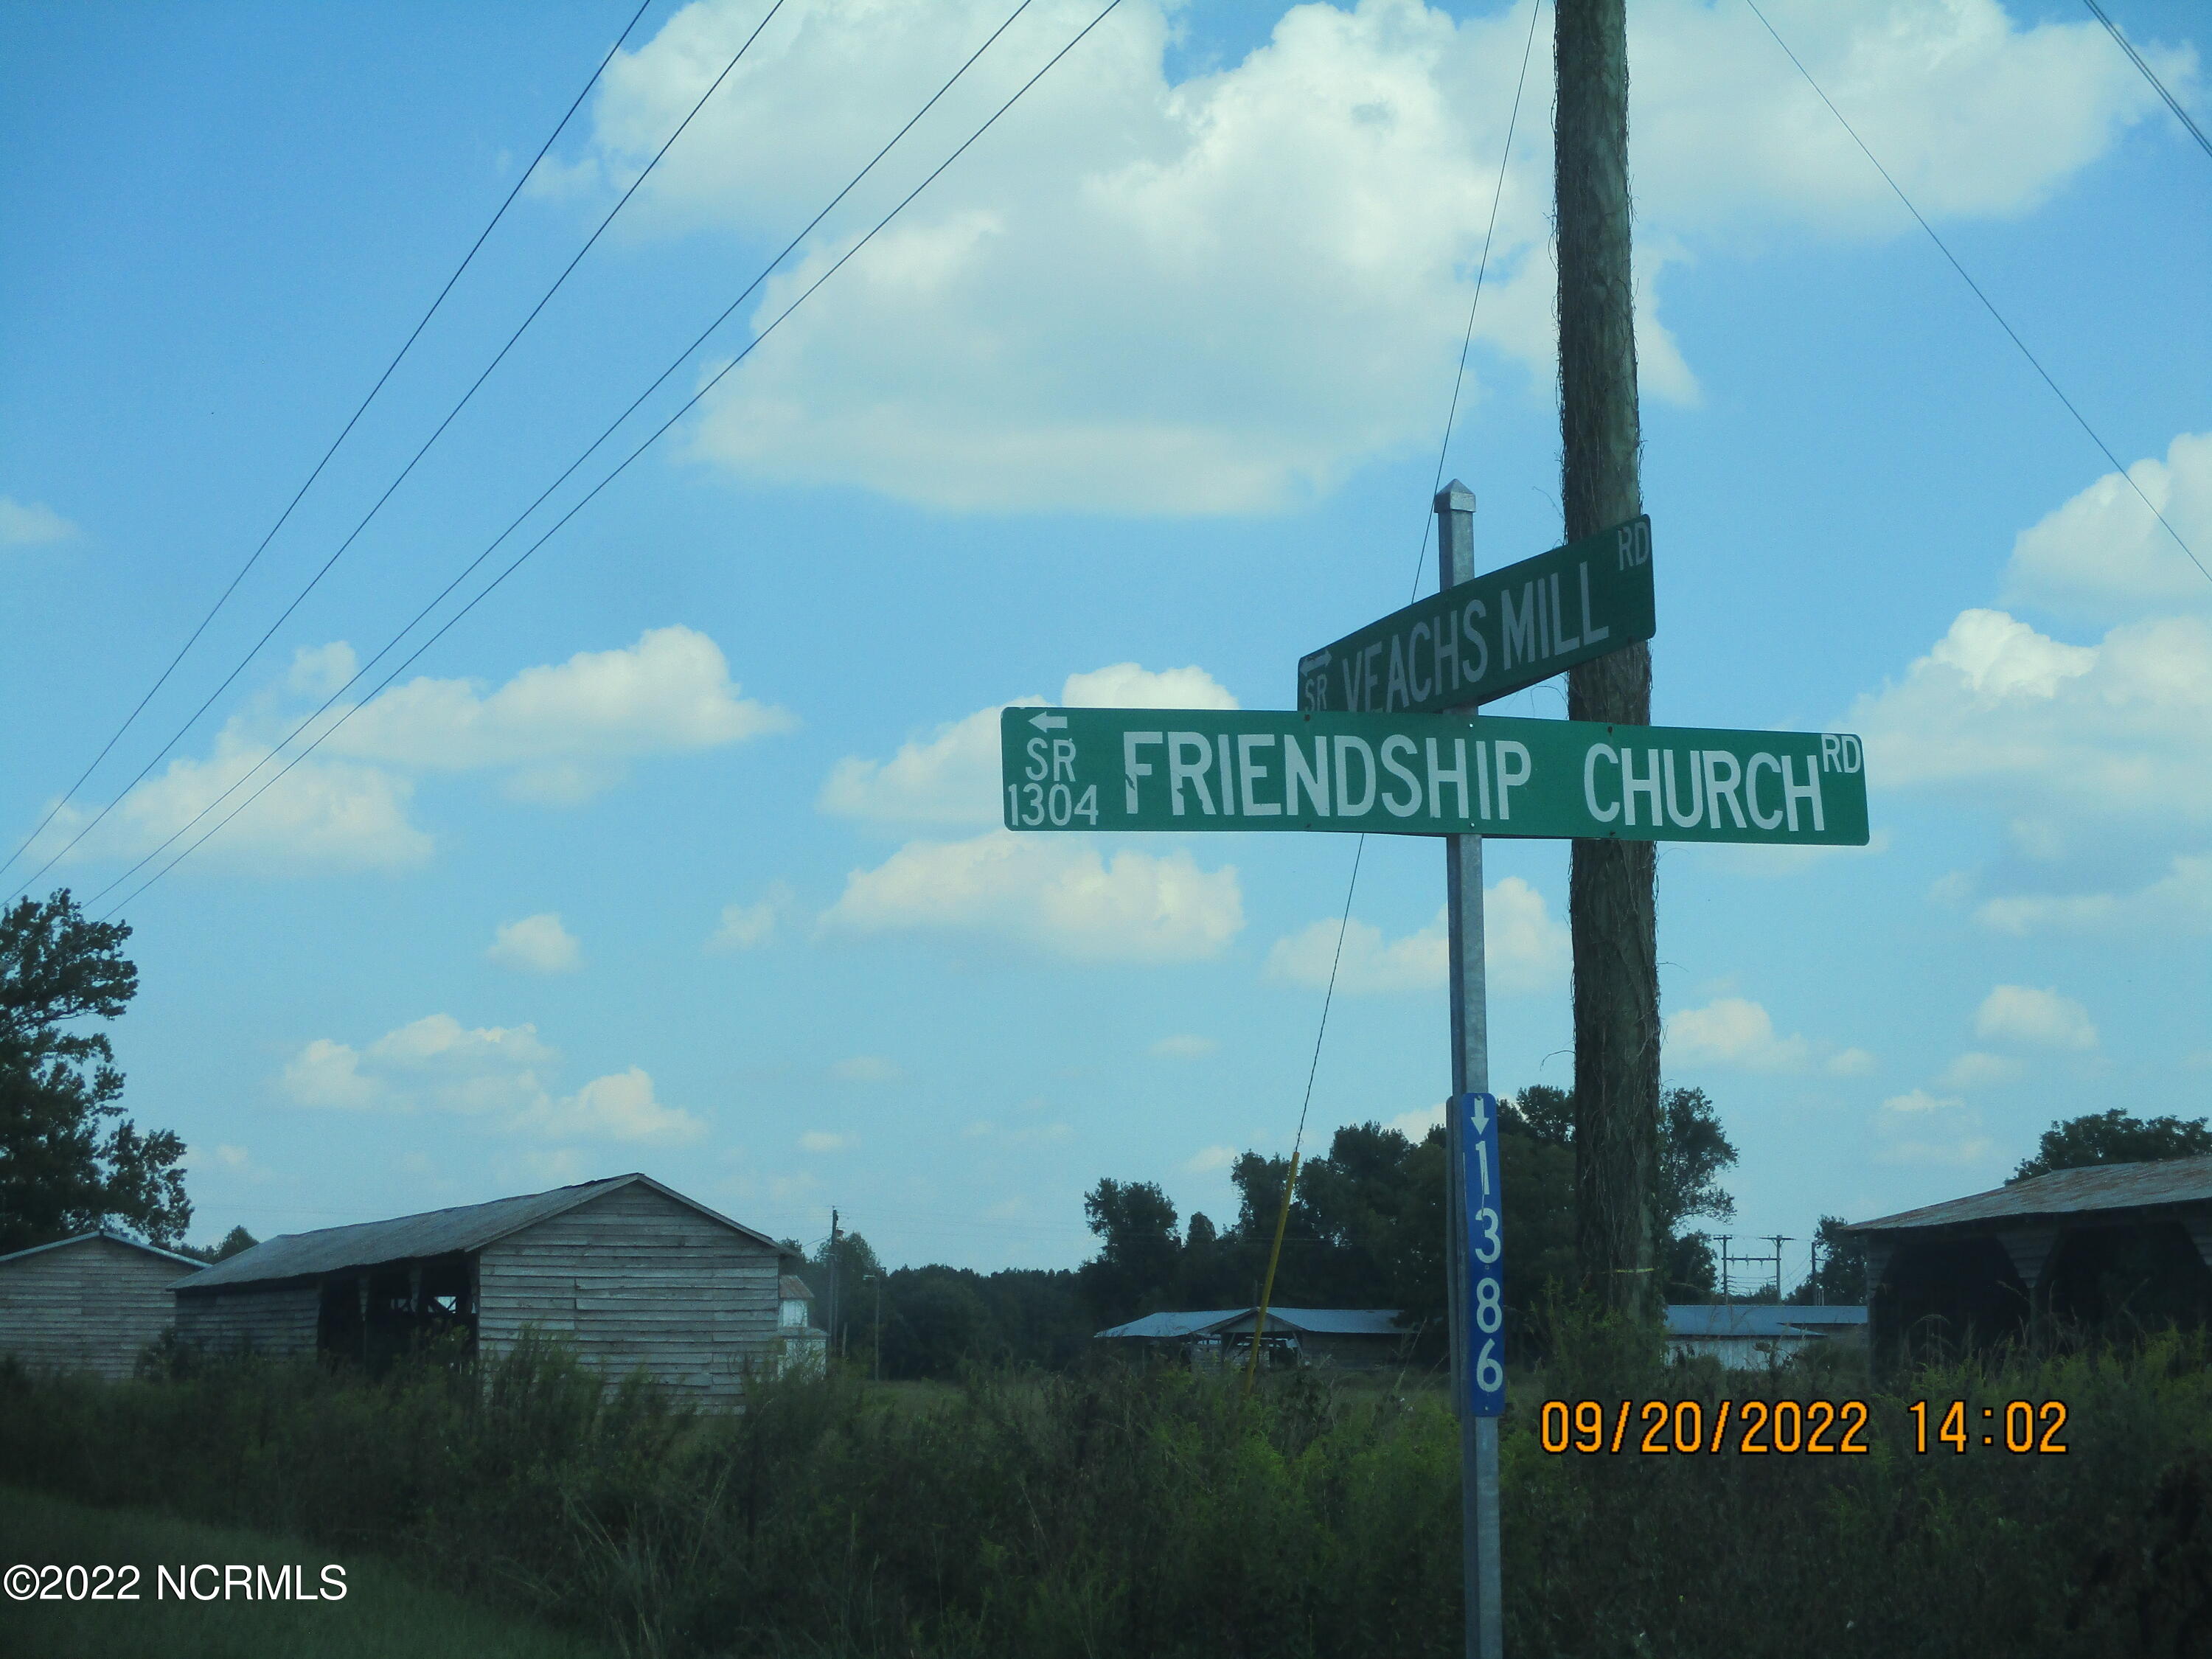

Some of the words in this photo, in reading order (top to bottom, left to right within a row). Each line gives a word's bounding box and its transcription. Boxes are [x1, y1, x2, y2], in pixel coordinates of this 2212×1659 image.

[1343, 599, 1489, 713] VEACHS
[1501, 561, 1609, 671] MILL
[1618, 521, 1649, 571] RD
[1304, 673, 1327, 712] SR
[1026, 738, 1077, 782] SR
[1123, 731, 1532, 821] FRIENDSHIP
[1584, 743, 1825, 832] CHURCH
[1821, 734, 1861, 773] RD
[1008, 783, 1099, 827] 1304
[1475, 1141, 1503, 1393] 1386
